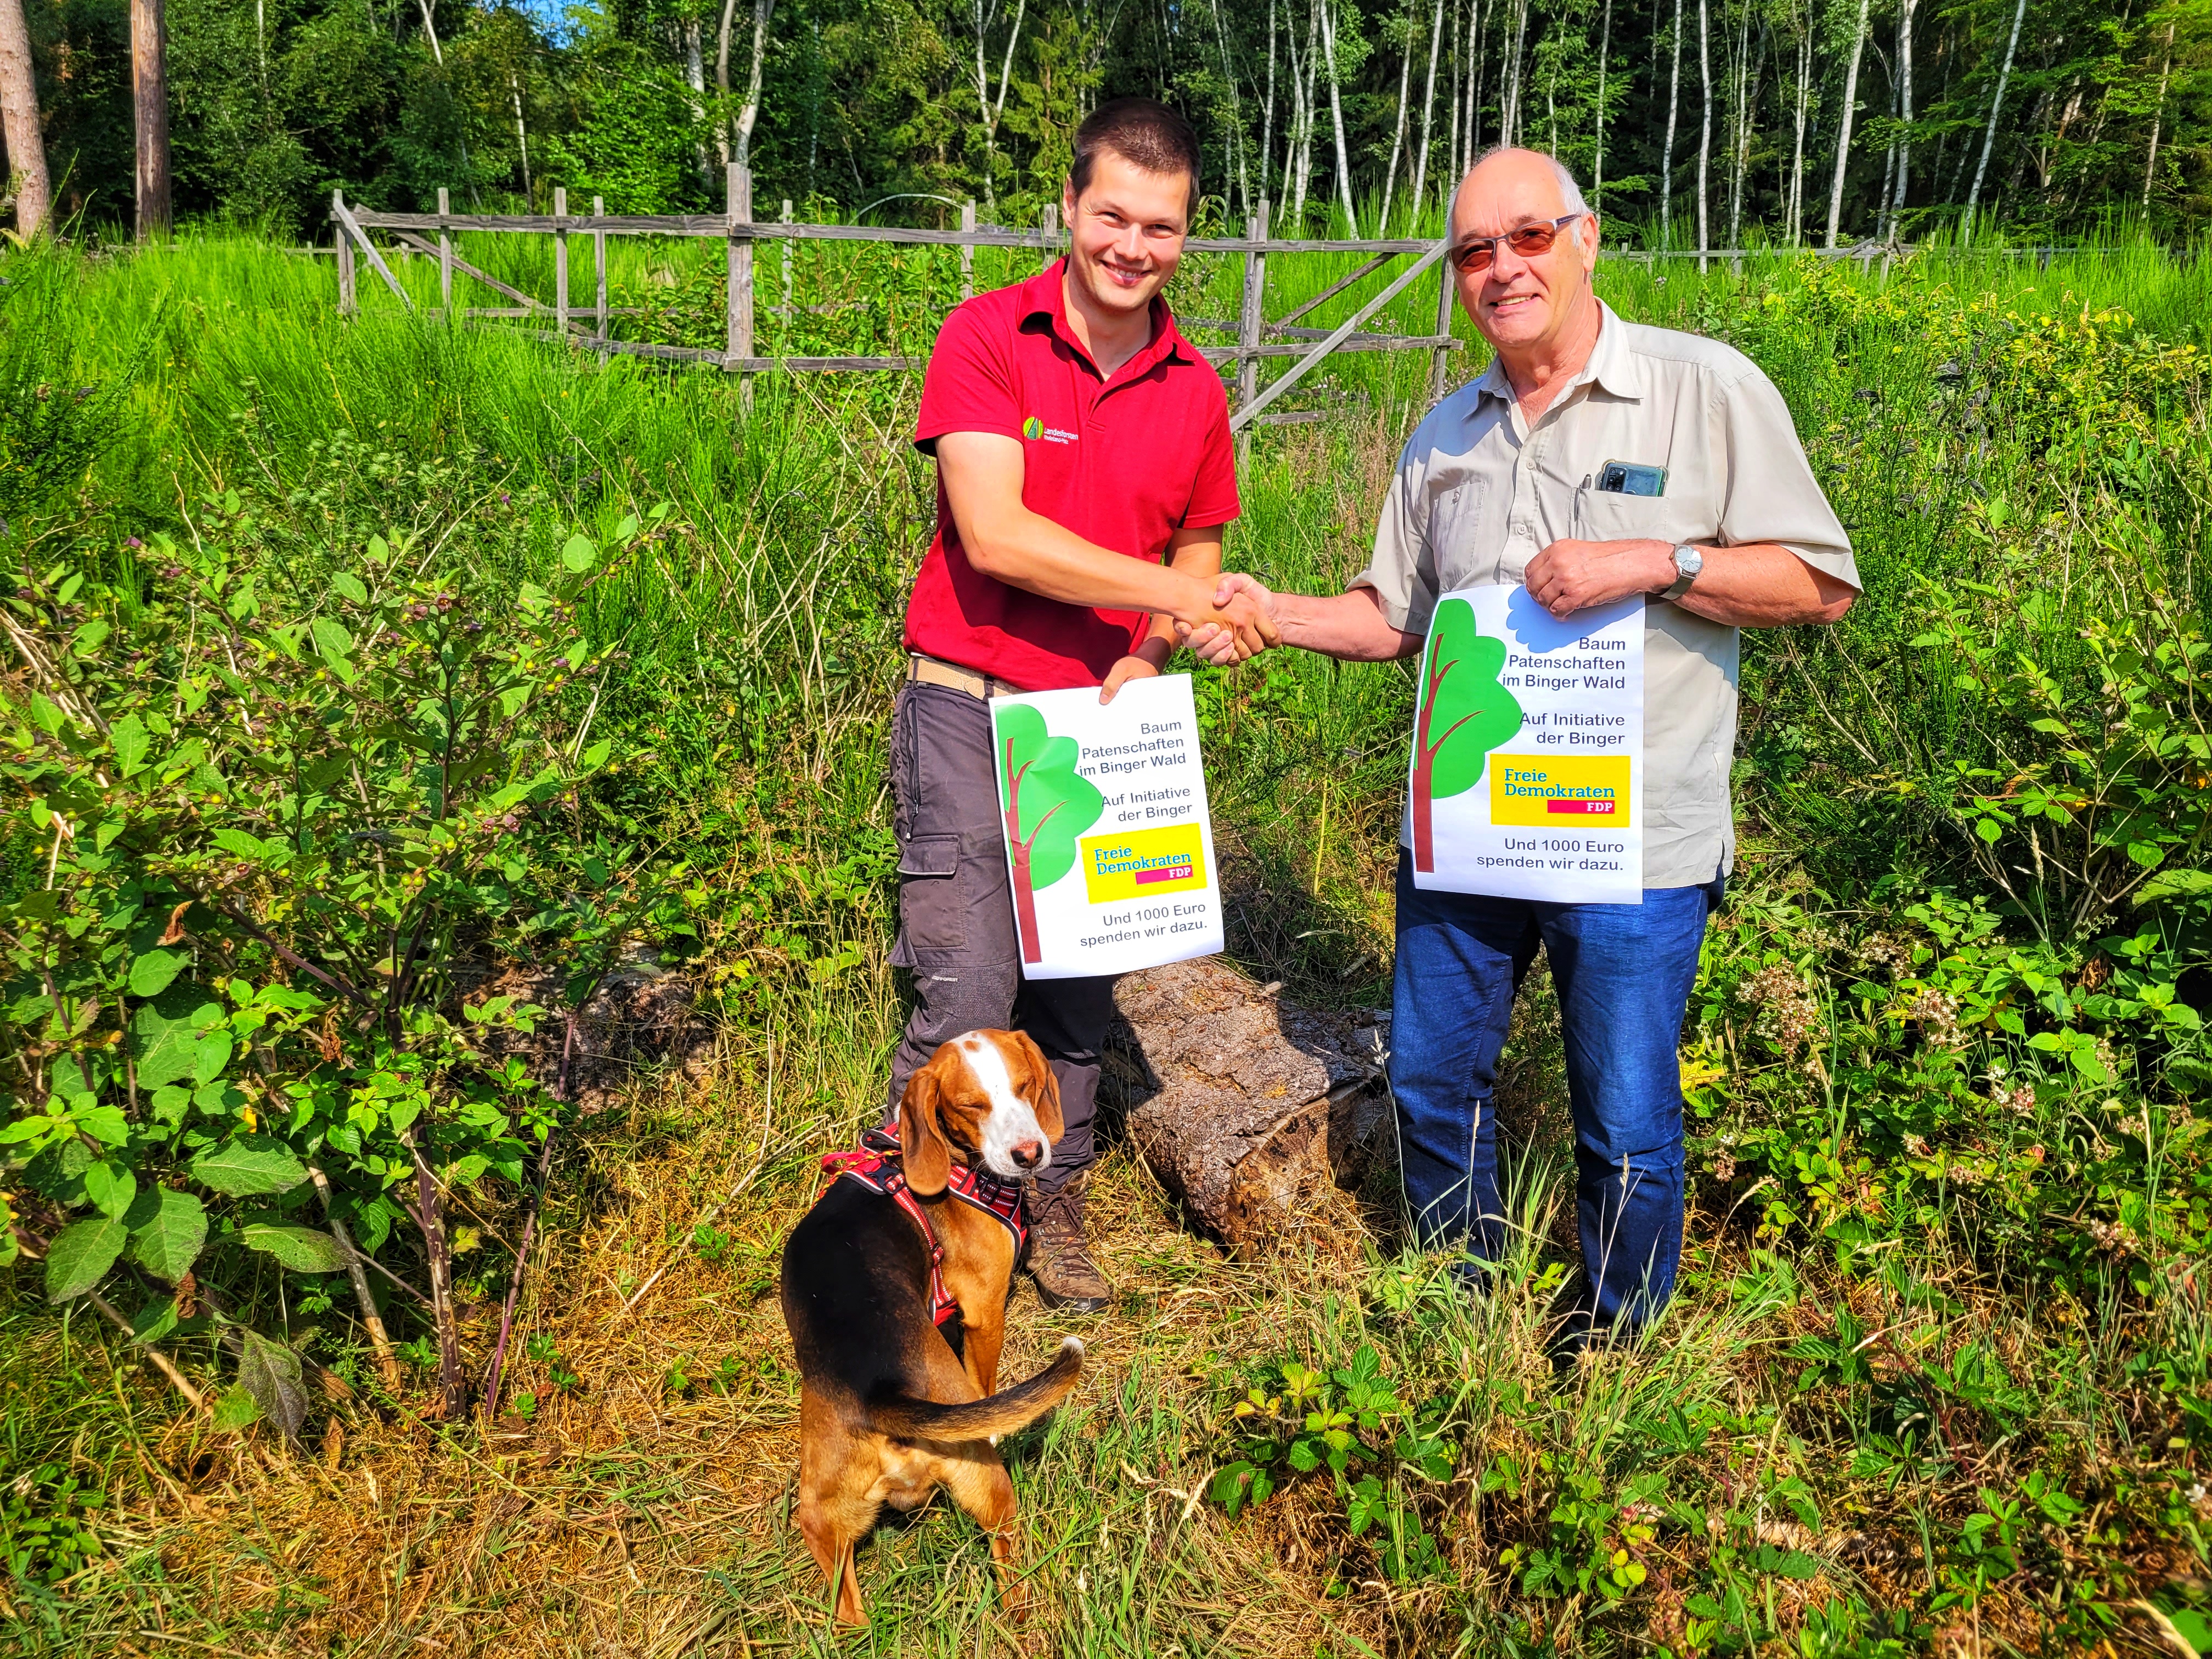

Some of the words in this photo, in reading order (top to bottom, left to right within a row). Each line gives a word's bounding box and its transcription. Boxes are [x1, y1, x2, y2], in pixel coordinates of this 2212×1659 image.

[1044, 427, 1079, 440] Landesforsten
[1578, 636, 1626, 651] Baum
[1509, 654, 1625, 670] Patenschaften
[1503, 673, 1520, 687] im
[1525, 674, 1579, 691] Binger
[1583, 675, 1625, 689] Wald
[1519, 712, 1548, 725] Auf
[1554, 713, 1625, 726] Initiative
[1141, 721, 1181, 734] Baum
[1537, 731, 1565, 744] der
[1570, 732, 1626, 748] Binger
[1082, 738, 1184, 760] Patenschaften
[1080, 766, 1096, 776] im
[1099, 759, 1147, 774] Binger
[1150, 753, 1186, 767] Wald
[1505, 768, 1547, 782] Freie
[1101, 794, 1124, 808] Auf
[1130, 788, 1190, 803] Initiative
[1505, 783, 1615, 798] Demokraten
[1118, 810, 1141, 822] der
[1146, 805, 1192, 818] Binger
[1587, 802, 1613, 812] FDP
[1094, 845, 1132, 861] Freie
[1505, 838, 1536, 850] Und
[1542, 839, 1581, 852] 1000
[1586, 840, 1624, 853] Euro
[1096, 853, 1192, 875] Demokraten
[1477, 856, 1544, 868] spenden
[1549, 857, 1575, 870] wir
[1579, 858, 1623, 871] dazu.
[1168, 867, 1192, 879] FDP
[1103, 912, 1131, 926] Und
[1136, 907, 1169, 921] 1000
[1173, 904, 1205, 916] Euro
[1080, 930, 1140, 948] spenden
[1144, 925, 1165, 937] wir
[1170, 921, 1207, 933] dazu.
